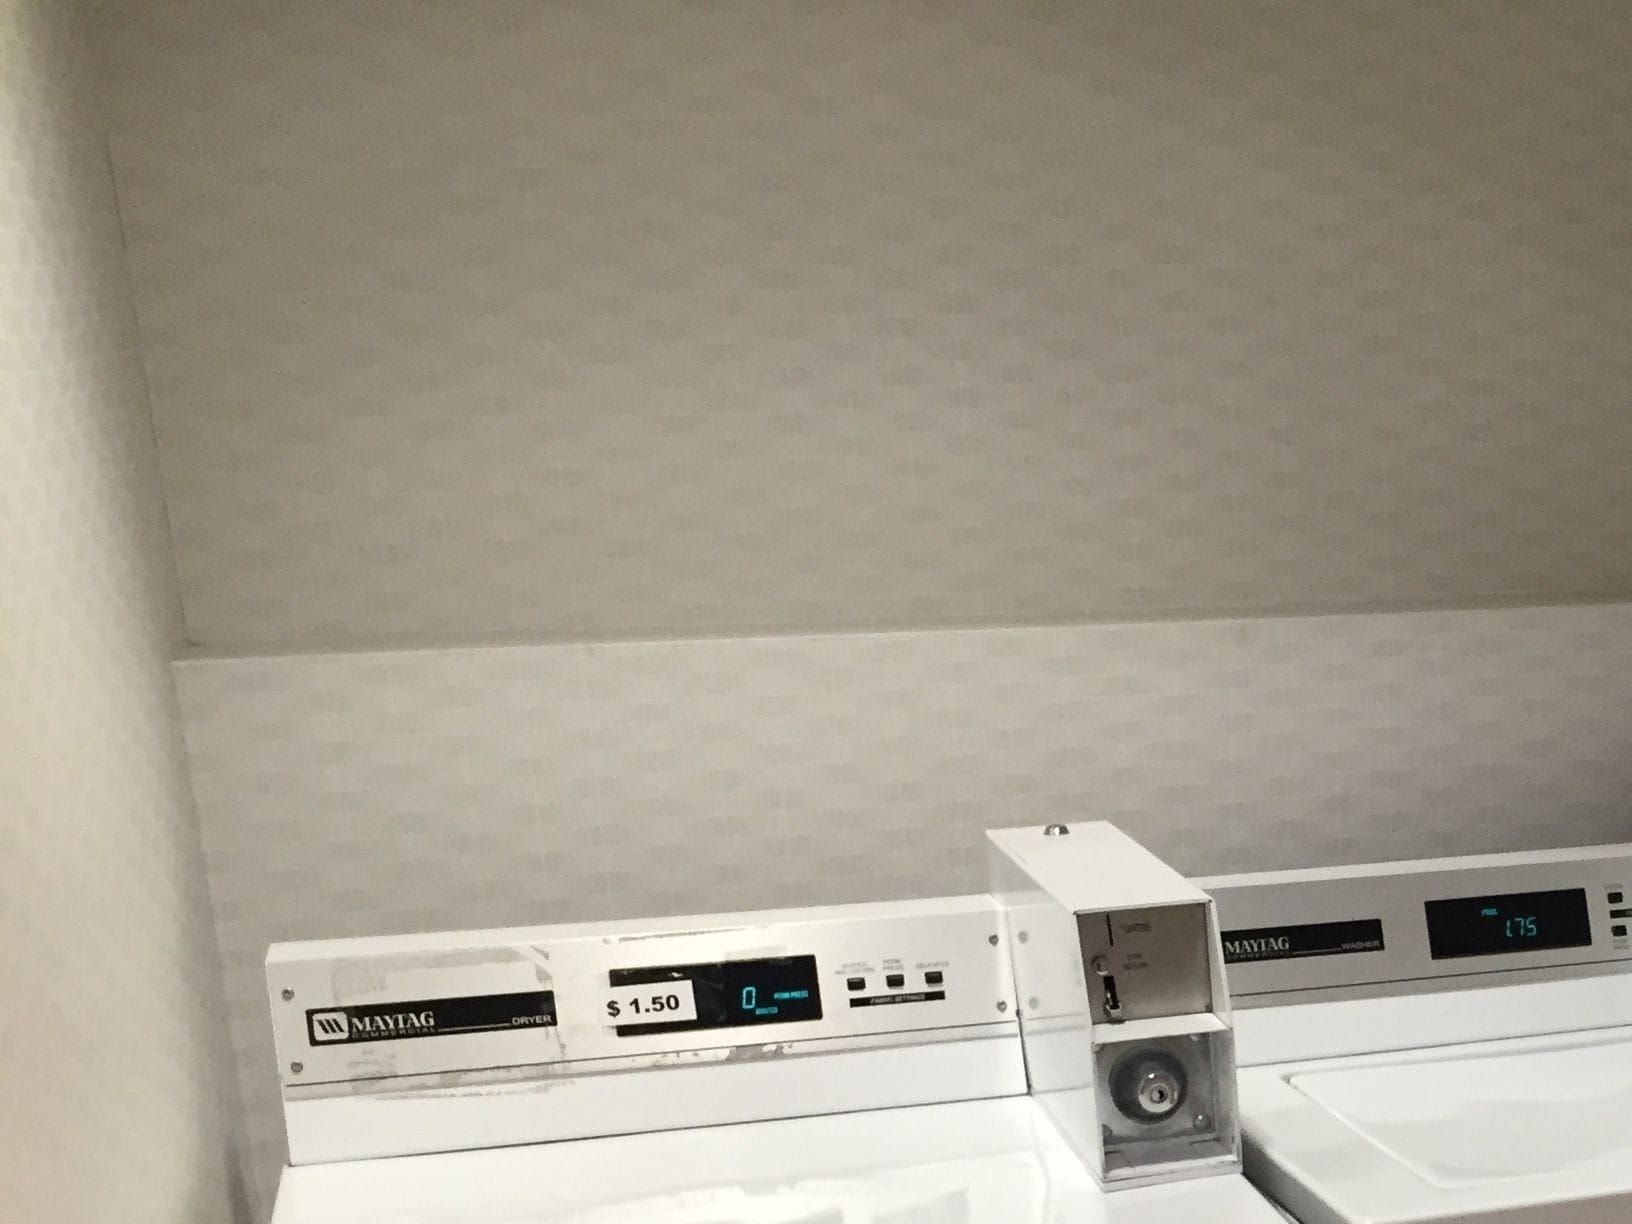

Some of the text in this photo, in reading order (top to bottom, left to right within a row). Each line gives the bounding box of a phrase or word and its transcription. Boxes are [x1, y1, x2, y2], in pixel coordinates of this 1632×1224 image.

[1224, 936, 1290, 954] MAYTAG
[606, 994, 680, 1018] $ 1.50
[742, 986, 756, 1009] 0
[351, 1010, 435, 1032] MAYTAG
[511, 1014, 552, 1026] DRYER
